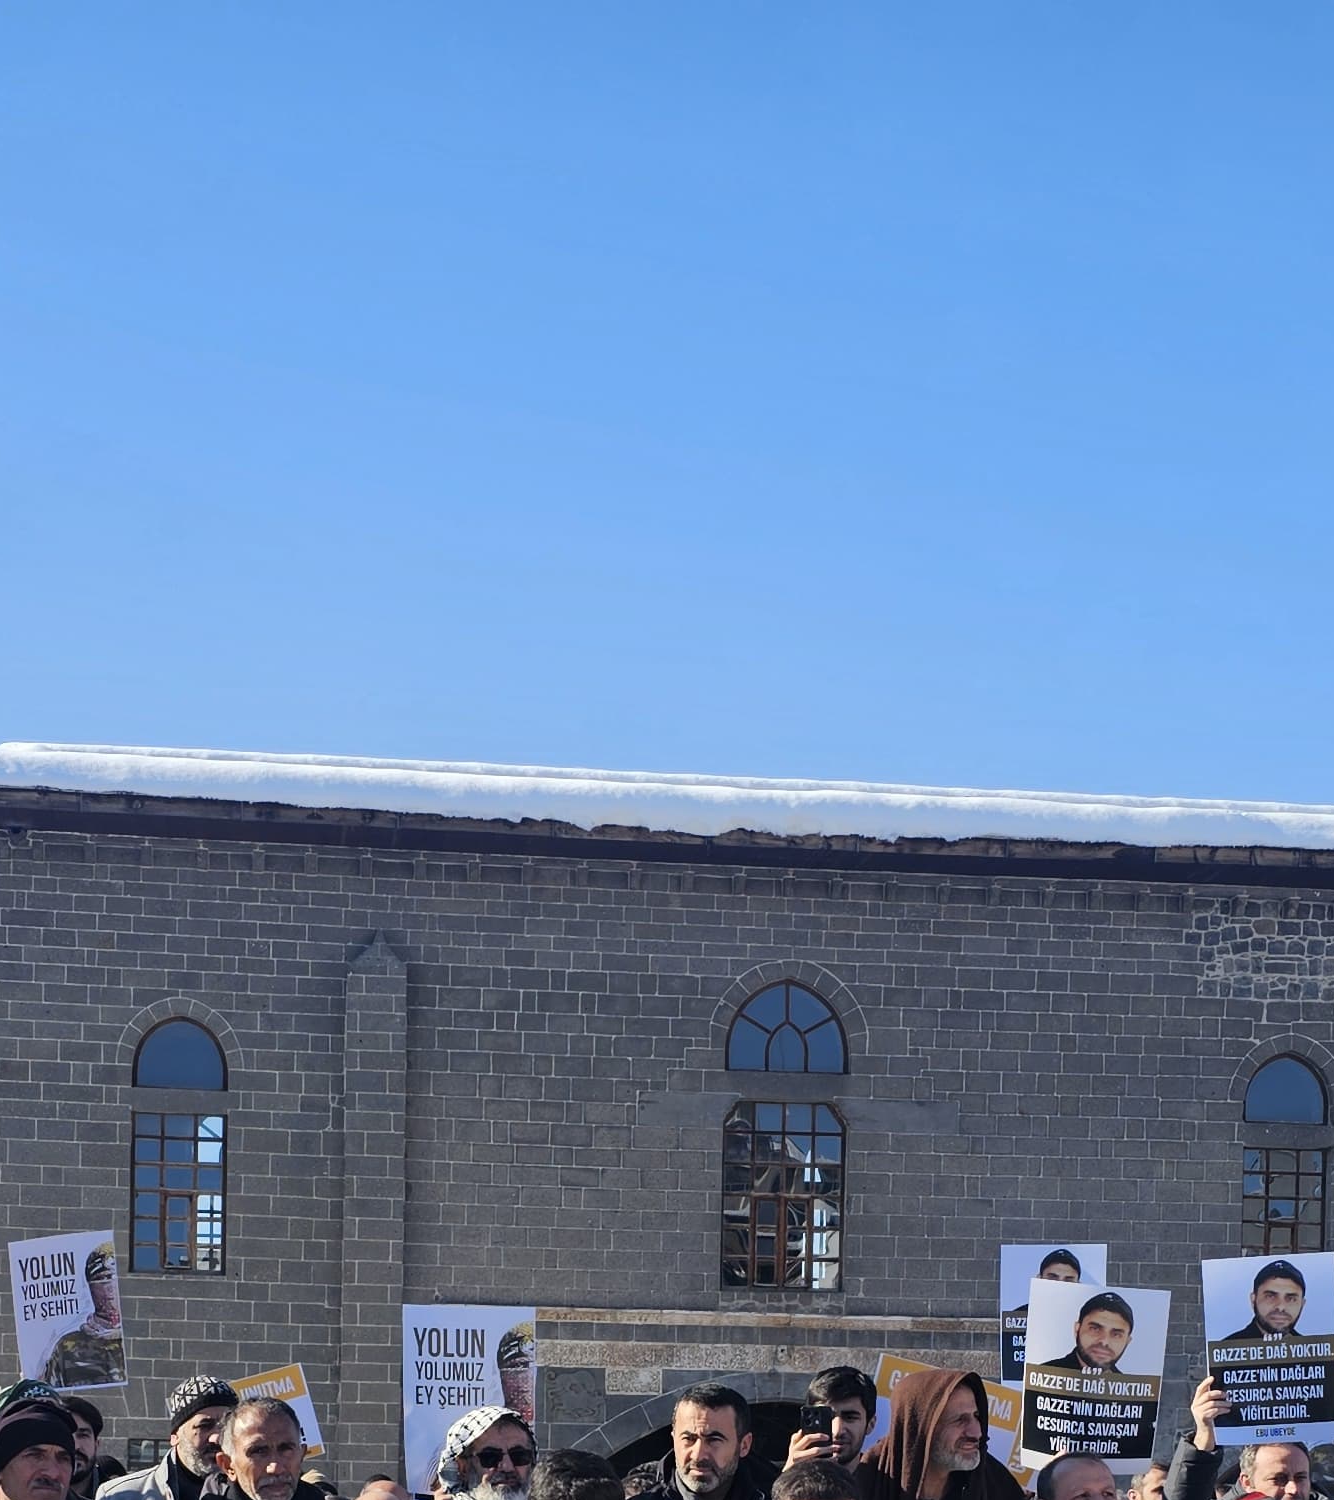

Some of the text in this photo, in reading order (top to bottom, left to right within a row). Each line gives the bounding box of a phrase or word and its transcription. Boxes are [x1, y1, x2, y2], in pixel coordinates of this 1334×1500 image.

[18, 1252, 75, 1282] YOLUN
[21, 1279, 76, 1301] YOLUMUZ
[23, 1297, 79, 1321] EY ŞEHİT!
[1005, 1317, 1027, 1329] GAZZ
[413, 1327, 485, 1358] YOLUN
[1213, 1342, 1334, 1362] GAZZE'DE DAĞ YOKTUR.
[415, 1361, 484, 1381] YOLUMUZ
[1223, 1364, 1325, 1384] GAZZE'NİN DAĞLARI
[1029, 1372, 1155, 1397] GAZZE'DE DAĞ YOKTUR.
[1226, 1384, 1324, 1403] CESURCA SAVAŞAN
[415, 1384, 485, 1409] EY ŞEHİT!
[1036, 1396, 1142, 1418] GAZZE'NİN DAĞLARI
[1240, 1402, 1311, 1422] YİĞİTLERİDİR.
[1037, 1415, 1138, 1439] CESURCA SAVAŞAN
